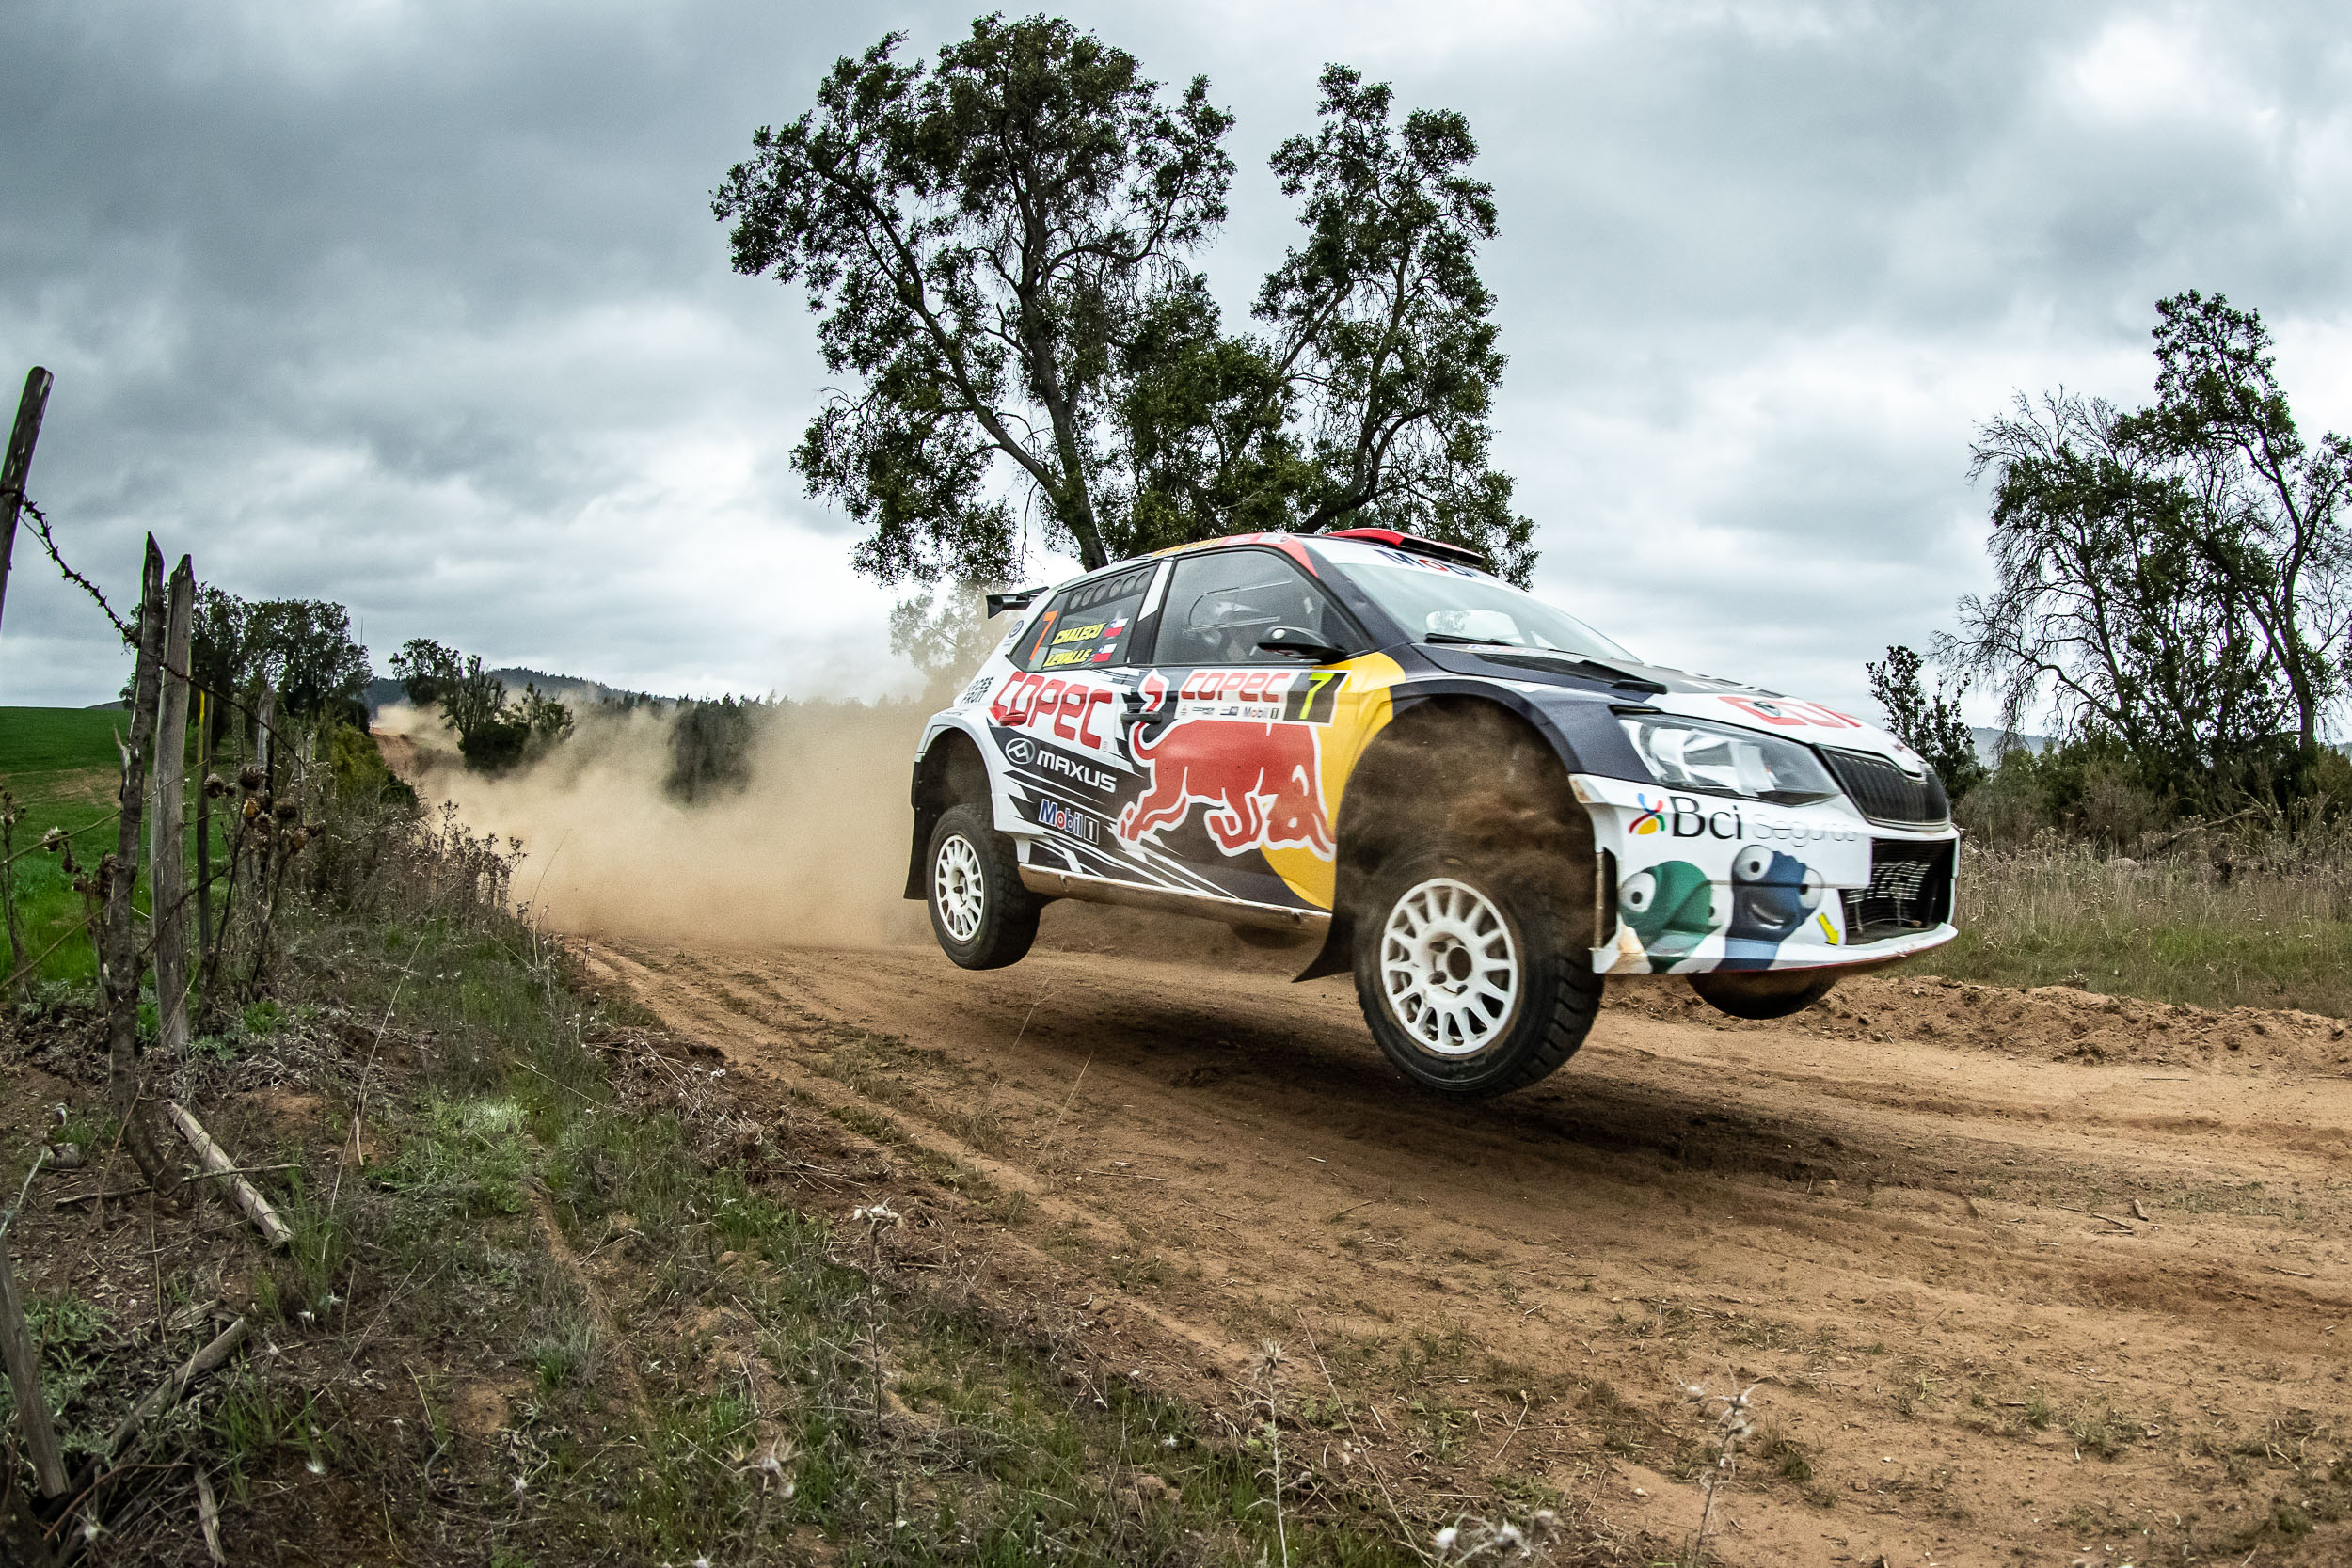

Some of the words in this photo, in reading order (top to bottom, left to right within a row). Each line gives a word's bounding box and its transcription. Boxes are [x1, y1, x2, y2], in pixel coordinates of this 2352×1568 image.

[1029, 610, 1058, 661] 7
[993, 671, 1113, 750] COPEC
[1181, 673, 1291, 703] COPEC
[1299, 673, 1335, 720] 7
[1036, 750, 1117, 793] MAXUS
[1038, 799, 1085, 839] Mobil
[1669, 796, 1743, 840] Bci
[1753, 814, 1859, 847] Seguros
